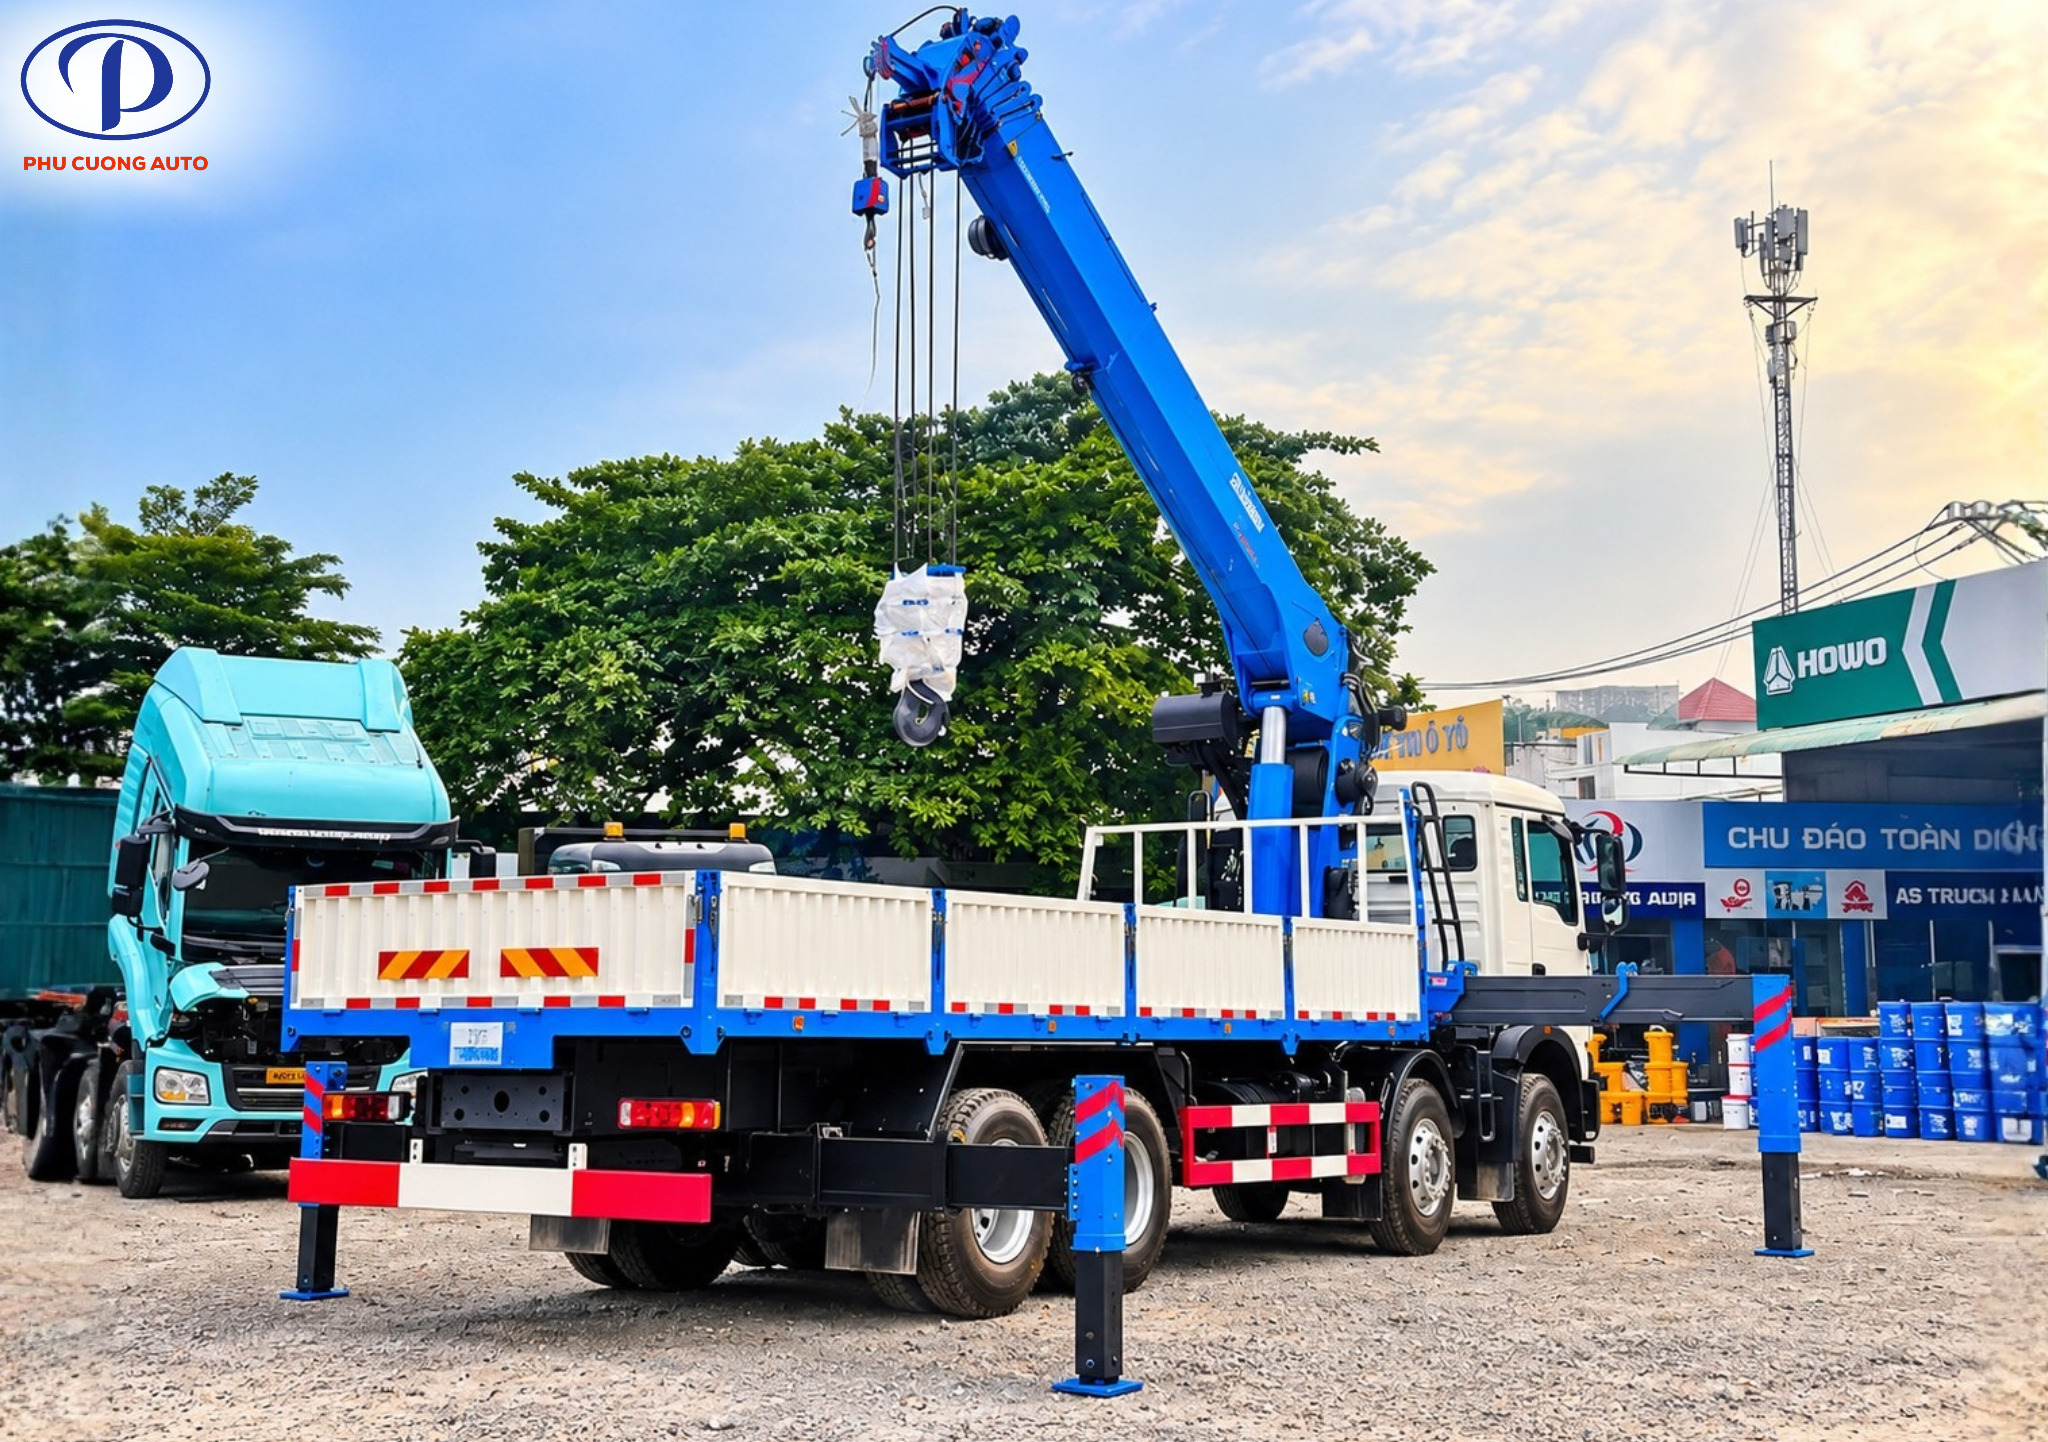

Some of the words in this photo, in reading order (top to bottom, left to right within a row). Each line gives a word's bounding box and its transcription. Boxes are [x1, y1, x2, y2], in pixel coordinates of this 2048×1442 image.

[1797, 636, 1887, 679] HOWO
[1727, 826, 1790, 850] CHU
[1802, 821, 1867, 850] ĐÁO
[1880, 822, 1961, 851] TOÀN
[1895, 887, 1923, 905] AS
